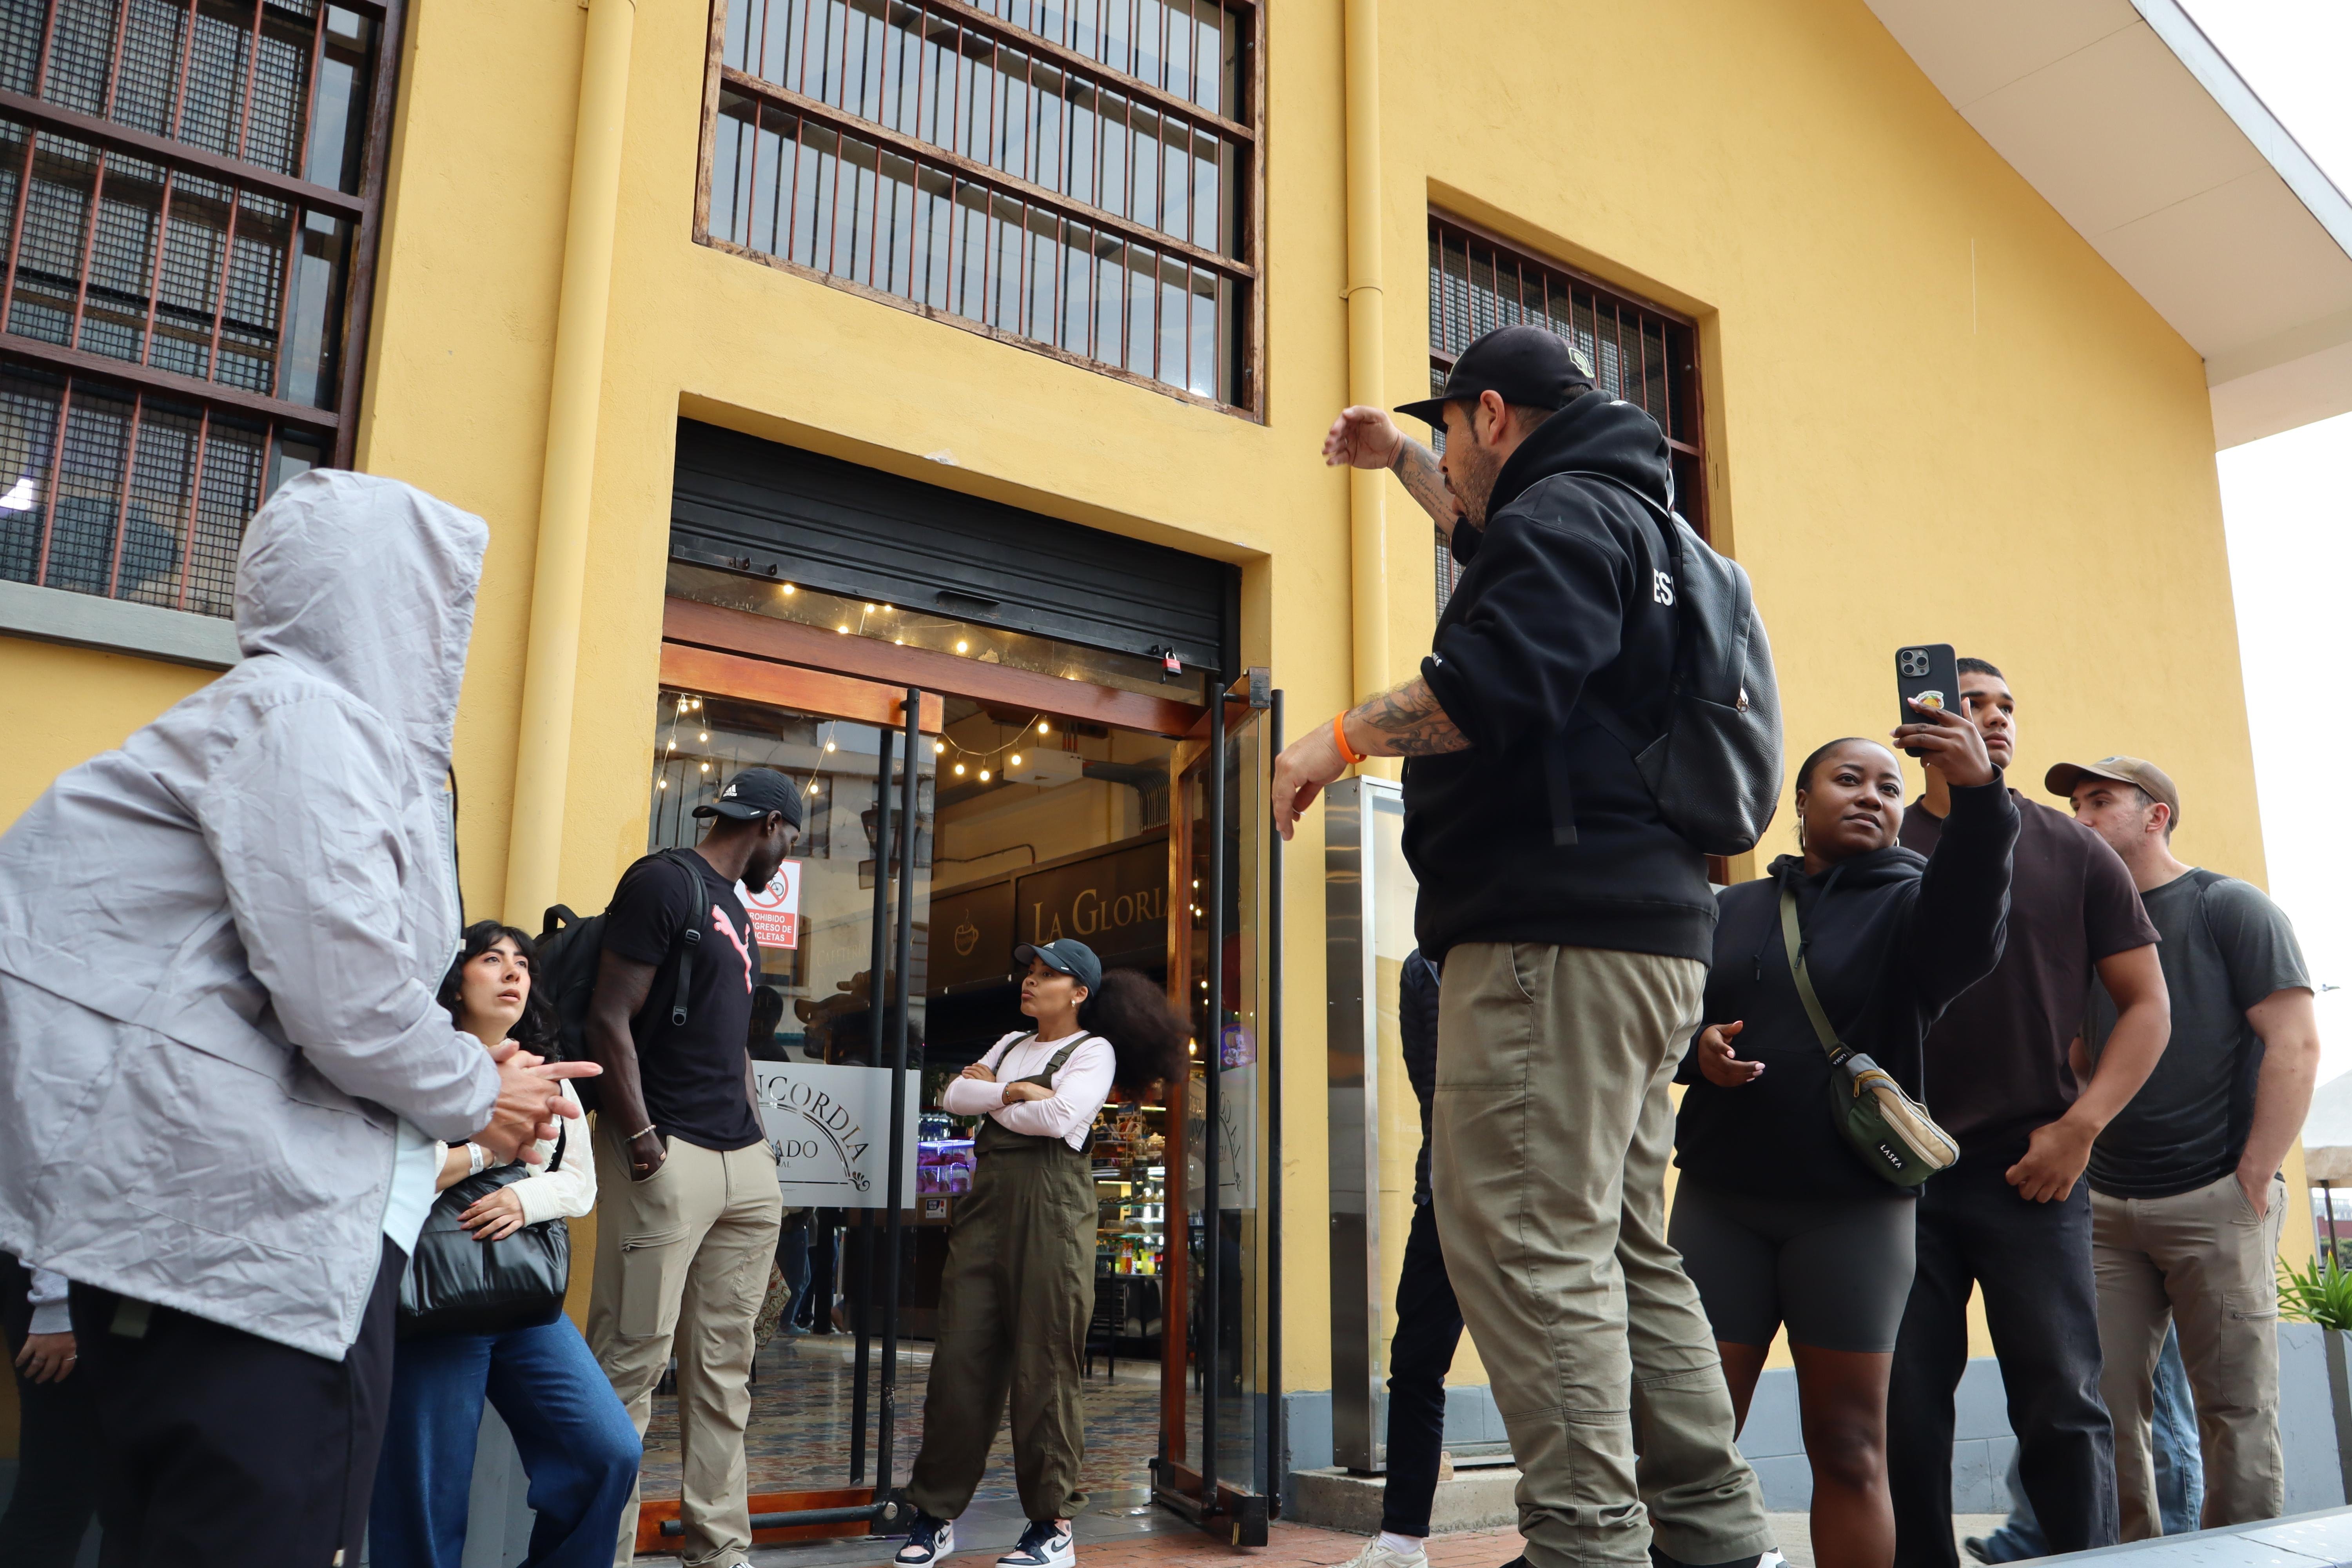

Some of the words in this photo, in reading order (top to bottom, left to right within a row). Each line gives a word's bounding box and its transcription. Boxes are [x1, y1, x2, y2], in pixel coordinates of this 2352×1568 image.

[1653, 568, 1677, 606] ES
[748, 912, 785, 923] ROHIBIDO
[1073, 887, 1168, 935] GLORI
[753, 922, 780, 932] GRESO
[782, 925, 792, 933] DE
[755, 932, 785, 942] ICLETAS
[1833, 1053, 1847, 1065] LASKA
[756, 1074, 869, 1163] NCORDIA
[775, 1139, 818, 1158] ADO
[1880, 1144, 1902, 1168] LASKA
